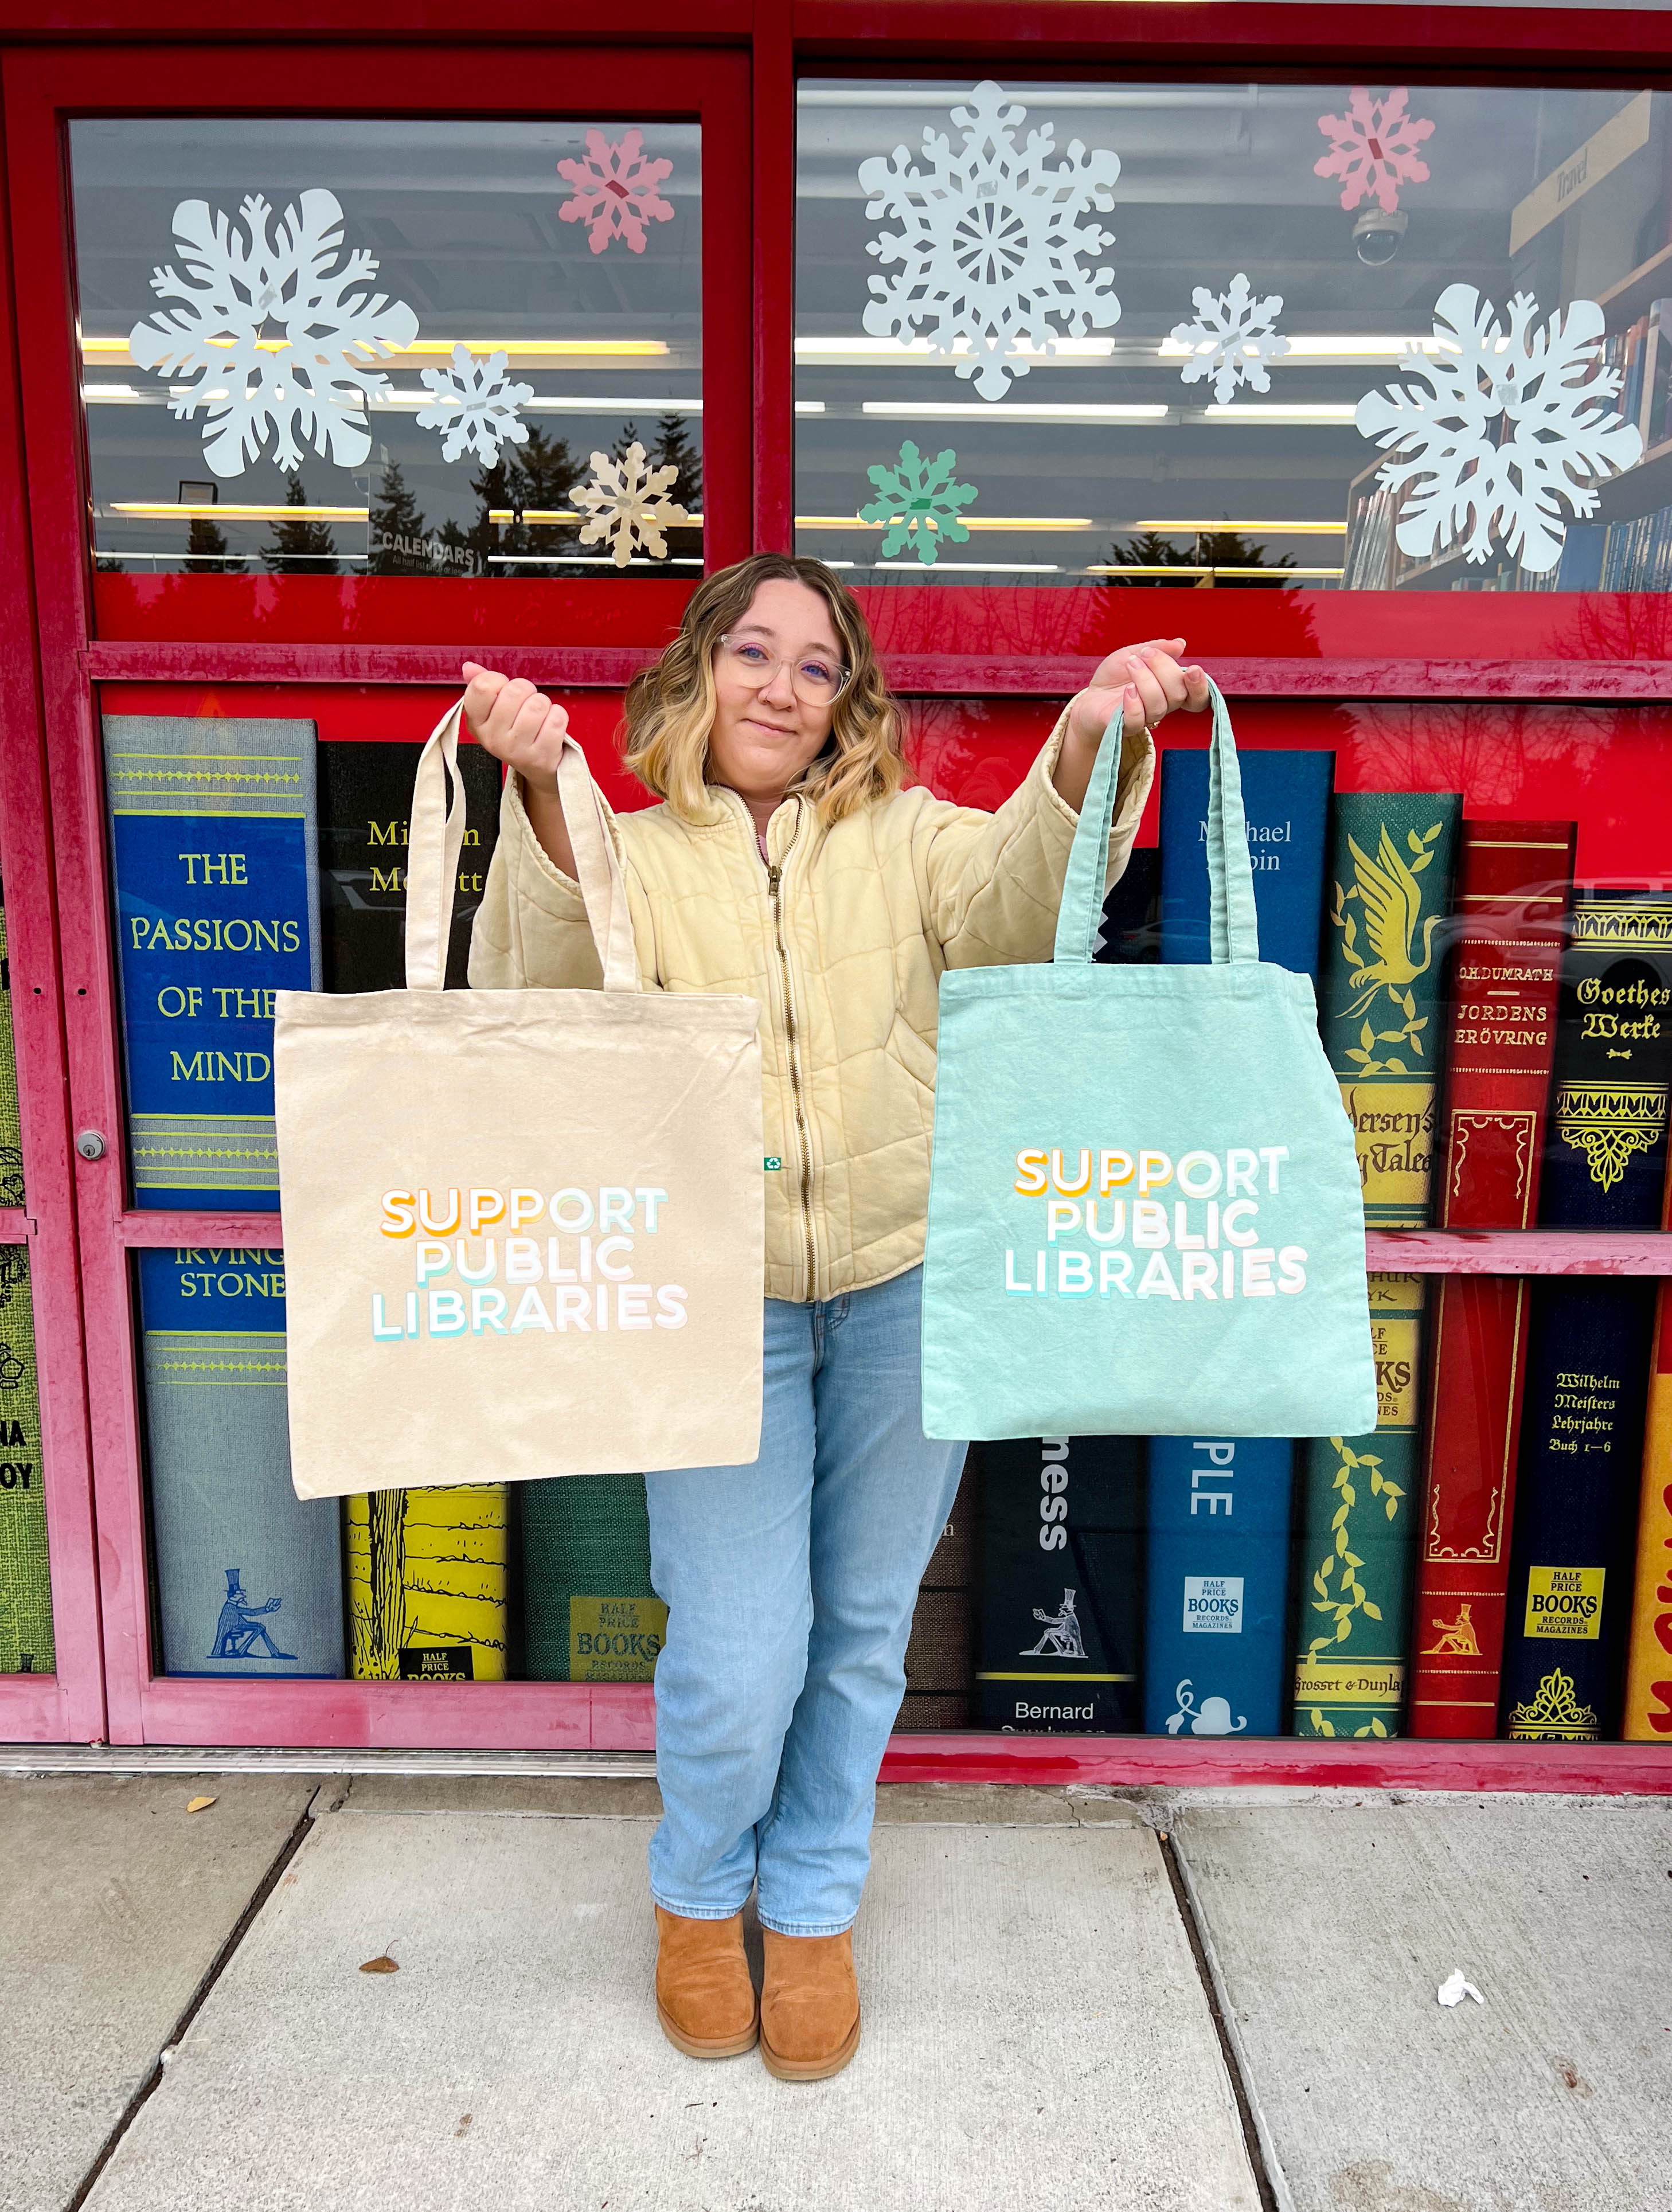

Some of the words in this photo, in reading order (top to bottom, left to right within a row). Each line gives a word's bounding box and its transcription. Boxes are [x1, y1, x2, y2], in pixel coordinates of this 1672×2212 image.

[1557, 147, 1587, 201] Travel
[382, 531, 474, 566] CALENDARS
[403, 558, 415, 567] half
[179, 854, 248, 885] THE
[131, 917, 300, 952] PASSIONS
[158, 986, 202, 1018] OF
[212, 988, 276, 1019] THE
[1577, 978, 1671, 1009] Goethes
[1457, 1005, 1547, 1021] JORDENS
[1454, 1028, 1547, 1045] ERÖVRING
[1581, 1013, 1661, 1039] Werke
[170, 1050, 271, 1082] MIND
[1014, 1147, 1290, 1199] SUPPORT
[380, 1187, 669, 1238] SUPPORT
[1048, 1198, 1259, 1249] PUBLIC
[416, 1236, 635, 1288] PUBLIC
[1006, 1245, 1308, 1301] LIBRARIES
[181, 1272, 286, 1297] STONE
[372, 1284, 688, 1341] LIBRARIES
[1557, 1373, 1620, 1392] Wilhelm
[1552, 1414, 1613, 1434] Lehrjahre
[1549, 1439, 1578, 1454] Buch
[1551, 1583, 1582, 1592] PRICE
[1553, 1572, 1581, 1581] HALF
[1188, 1598, 1239, 1616] BOOKS
[1532, 1594, 1597, 1618] BOOKS
[1537, 1625, 1588, 1634] MAGAZINES
[423, 1652, 447, 1661] HALF
[577, 1633, 661, 1662] BOOKS
[421, 1663, 449, 1671] PRICE
[1015, 1702, 1093, 1719] Bernard
